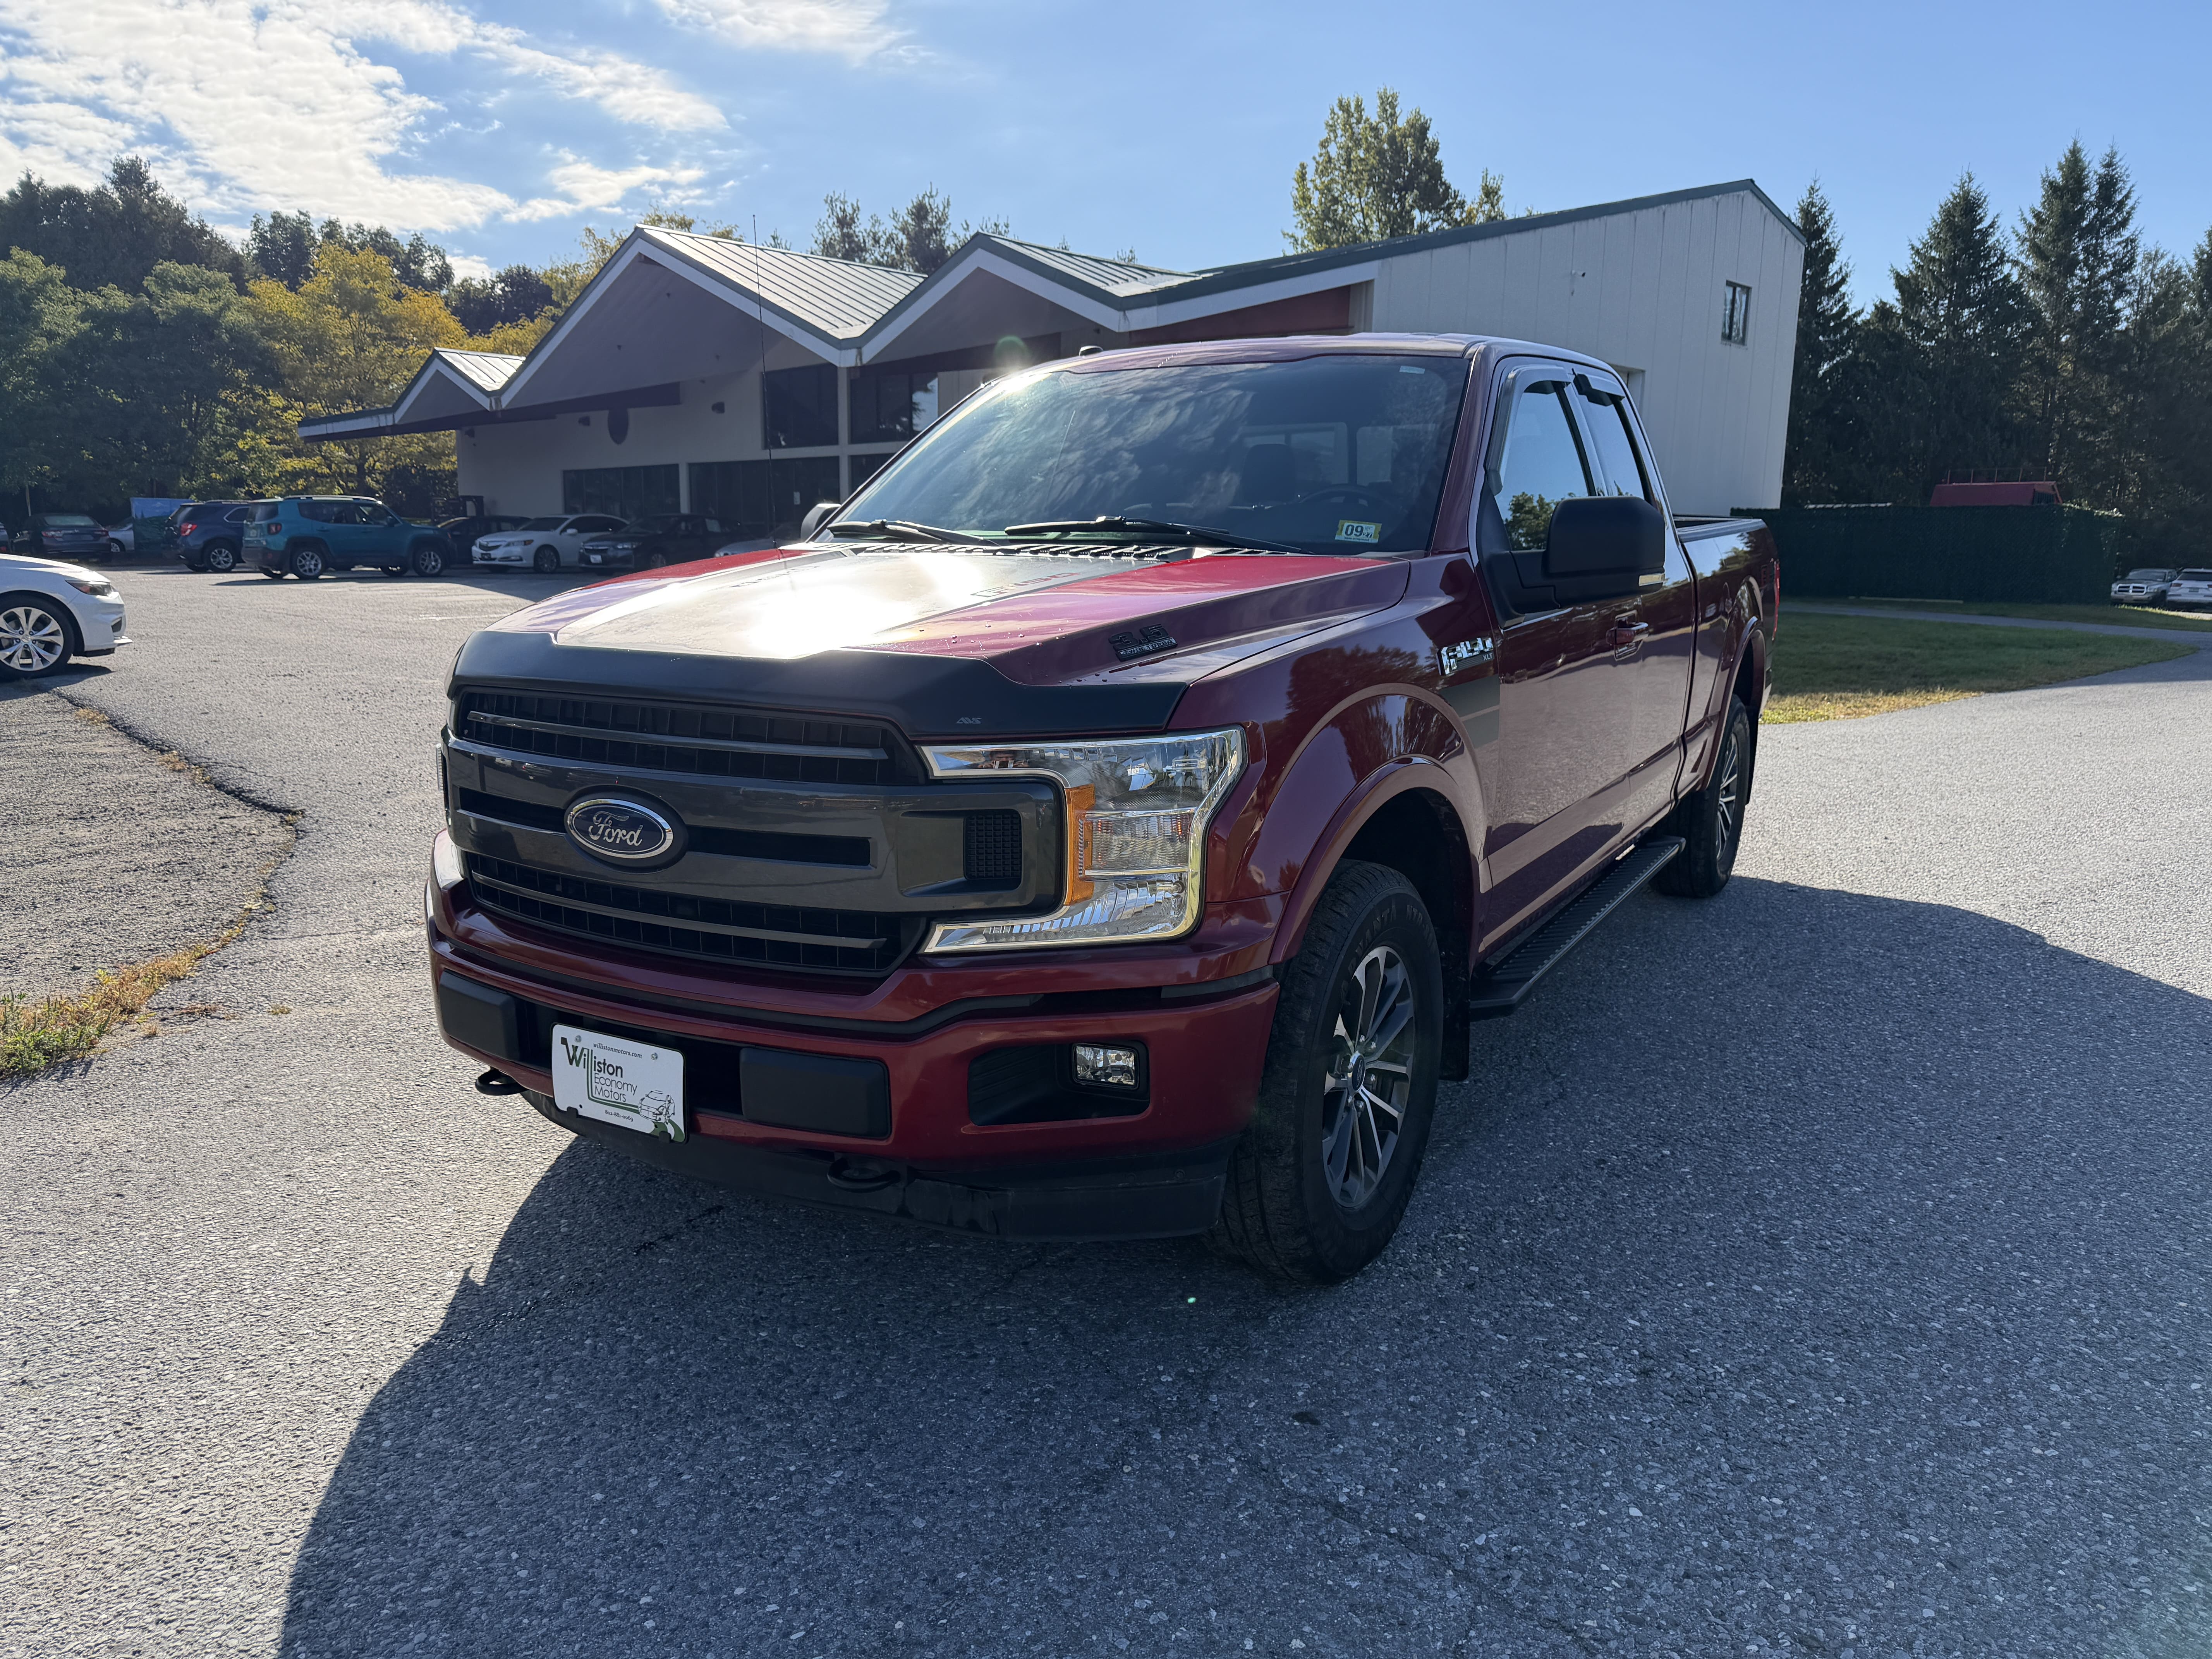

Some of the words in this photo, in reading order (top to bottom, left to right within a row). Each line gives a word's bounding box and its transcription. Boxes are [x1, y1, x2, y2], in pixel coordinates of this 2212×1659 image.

[1345, 524, 1364, 537] 09
[1109, 623, 1168, 650] 3.5
[588, 811, 643, 846] Ford
[561, 1037, 623, 1079] Williston
[593, 1043, 642, 1058] willistonmotors.com
[594, 1073, 638, 1096] Economy
[594, 1085, 627, 1103] Motors
[605, 1109, 634, 1122] 802-881-0069
